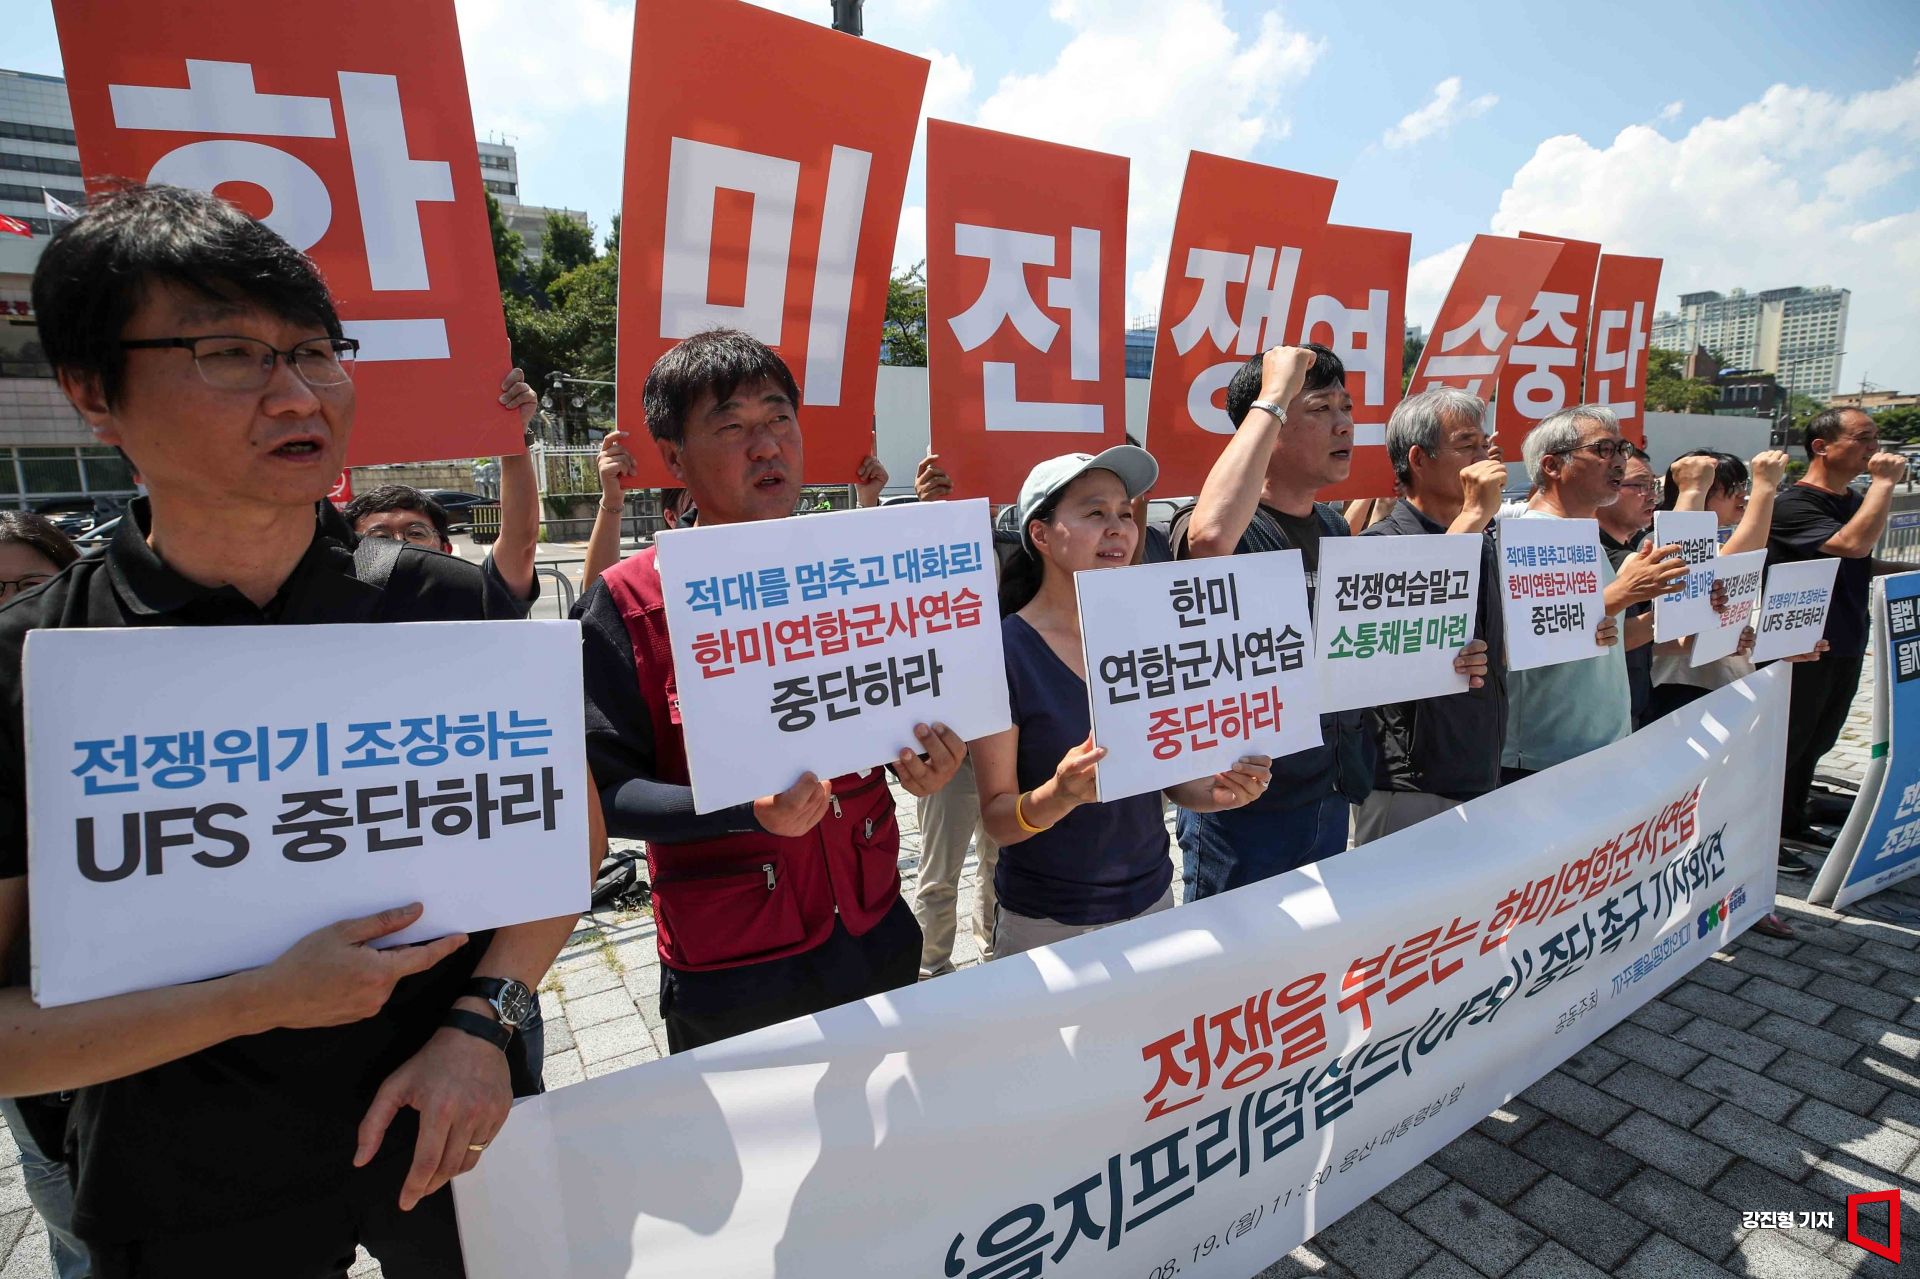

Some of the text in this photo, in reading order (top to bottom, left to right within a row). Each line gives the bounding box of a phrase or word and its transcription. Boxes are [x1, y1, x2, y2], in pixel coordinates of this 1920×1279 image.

[108, 58, 455, 361] 한
[660, 136, 873, 406] 미
[947, 222, 1105, 434] 전
[1170, 246, 1302, 434] 쟁
[1300, 289, 1390, 446] 연
[1508, 291, 1579, 419] 중
[1594, 301, 1647, 419] 단
[685, 542, 983, 616] 적대를 멈추고 대화로!
[1335, 569, 1470, 611] 전쟁연습말고
[1506, 544, 1596, 567] 적대를 멈추고 대화로!
[1508, 571, 1597, 599] 한미연합군사연습
[691, 587, 983, 680] 한미연합군사연습
[1169, 573, 1240, 628] 한미
[1328, 613, 1468, 660] 소통채널 마련
[1531, 602, 1585, 635] 중단하라
[1762, 606, 1824, 632] UFS 중단하라
[1768, 592, 1799, 610] 전쟁위기
[770, 649, 943, 732] 중단하라
[1100, 624, 1304, 705] 연합군사연습
[71, 711, 553, 796] 전쟁위기 조장하는
[1147, 686, 1283, 760] 중단하라
[76, 767, 564, 883] UFS 중단하라
[1525, 911, 1596, 999] 중단
[1598, 880, 1648, 954] 촉구
[1649, 822, 1727, 919] 기자회견
[1141, 784, 1701, 1122] 전쟁을 부르는 한미연합군사연습
[1554, 988, 1598, 1035] 공동주최
[1340, 1136, 1377, 1173] 용산
[1380, 1093, 1448, 1145] 대통령실
[1447, 1082, 1466, 1107] 앞
